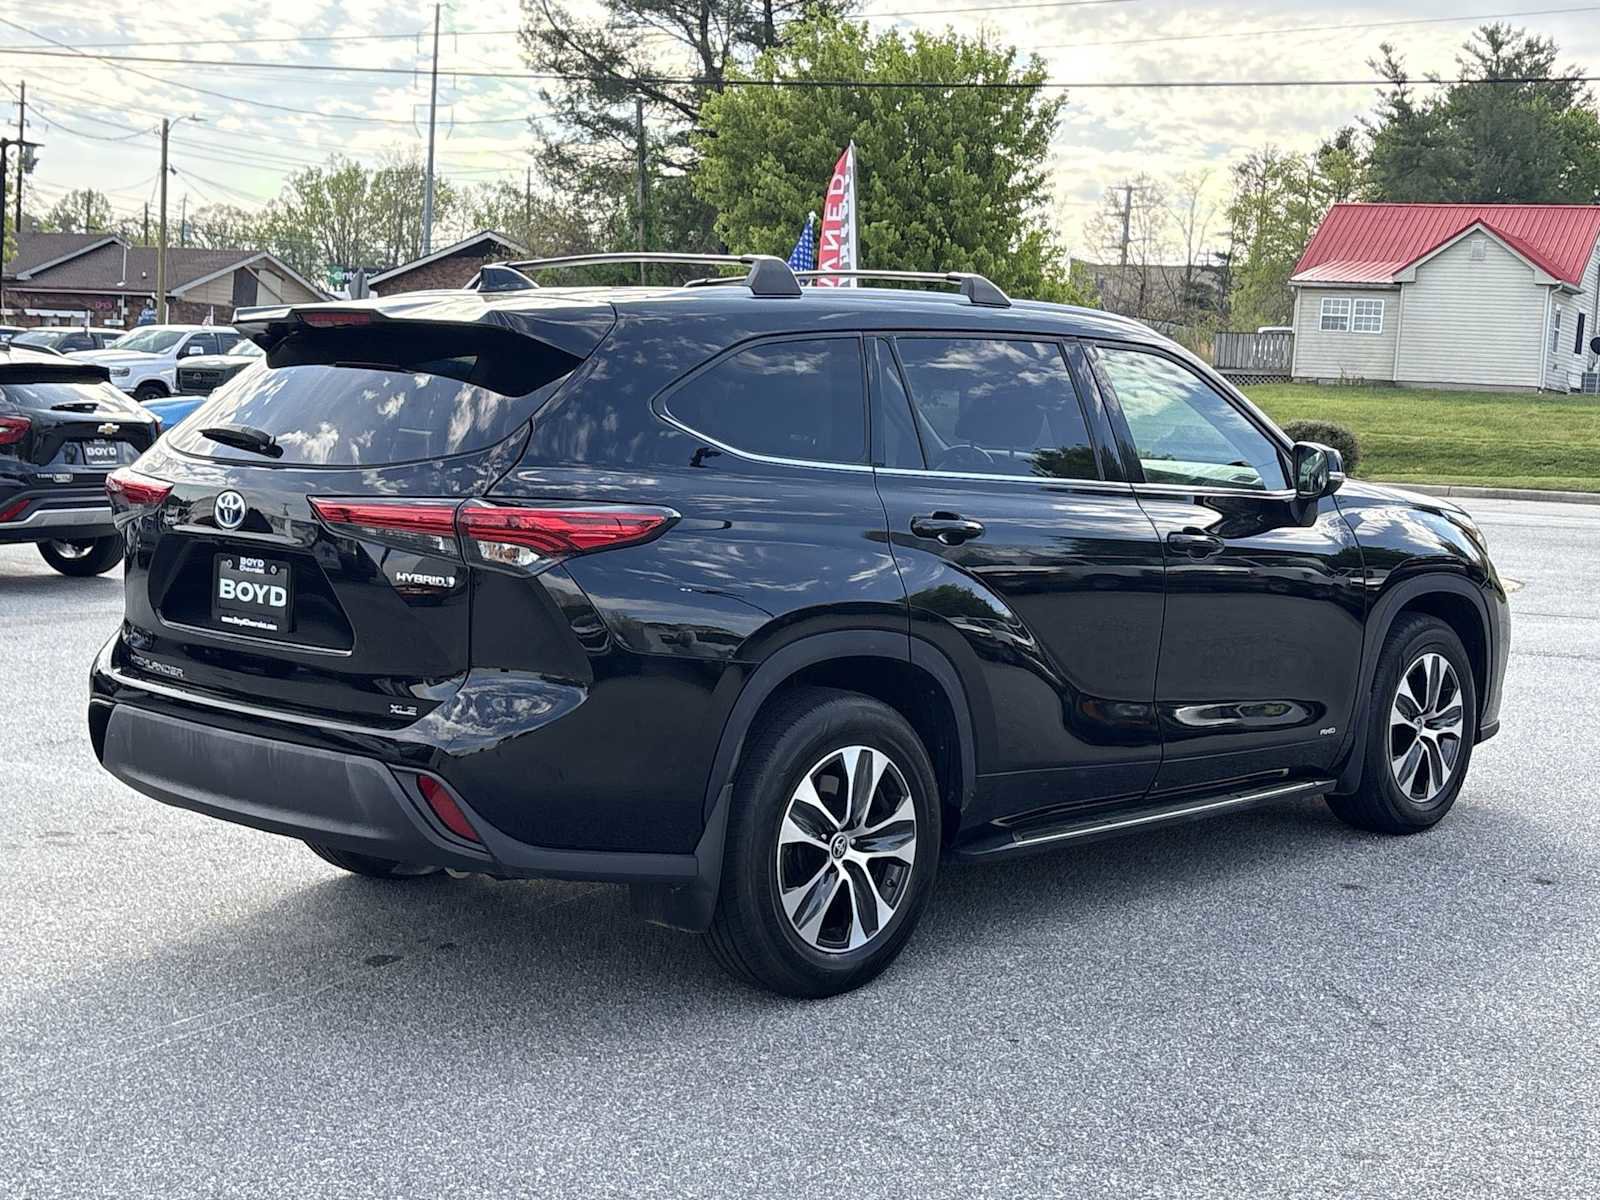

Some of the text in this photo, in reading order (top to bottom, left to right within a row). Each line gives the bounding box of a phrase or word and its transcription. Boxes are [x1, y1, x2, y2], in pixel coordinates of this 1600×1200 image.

[86, 447, 117, 456] BOYD
[240, 556, 265, 568] BOYD
[396, 572, 444, 587] HYBRID
[219, 578, 287, 607] BOYD
[390, 704, 417, 716] XLE
